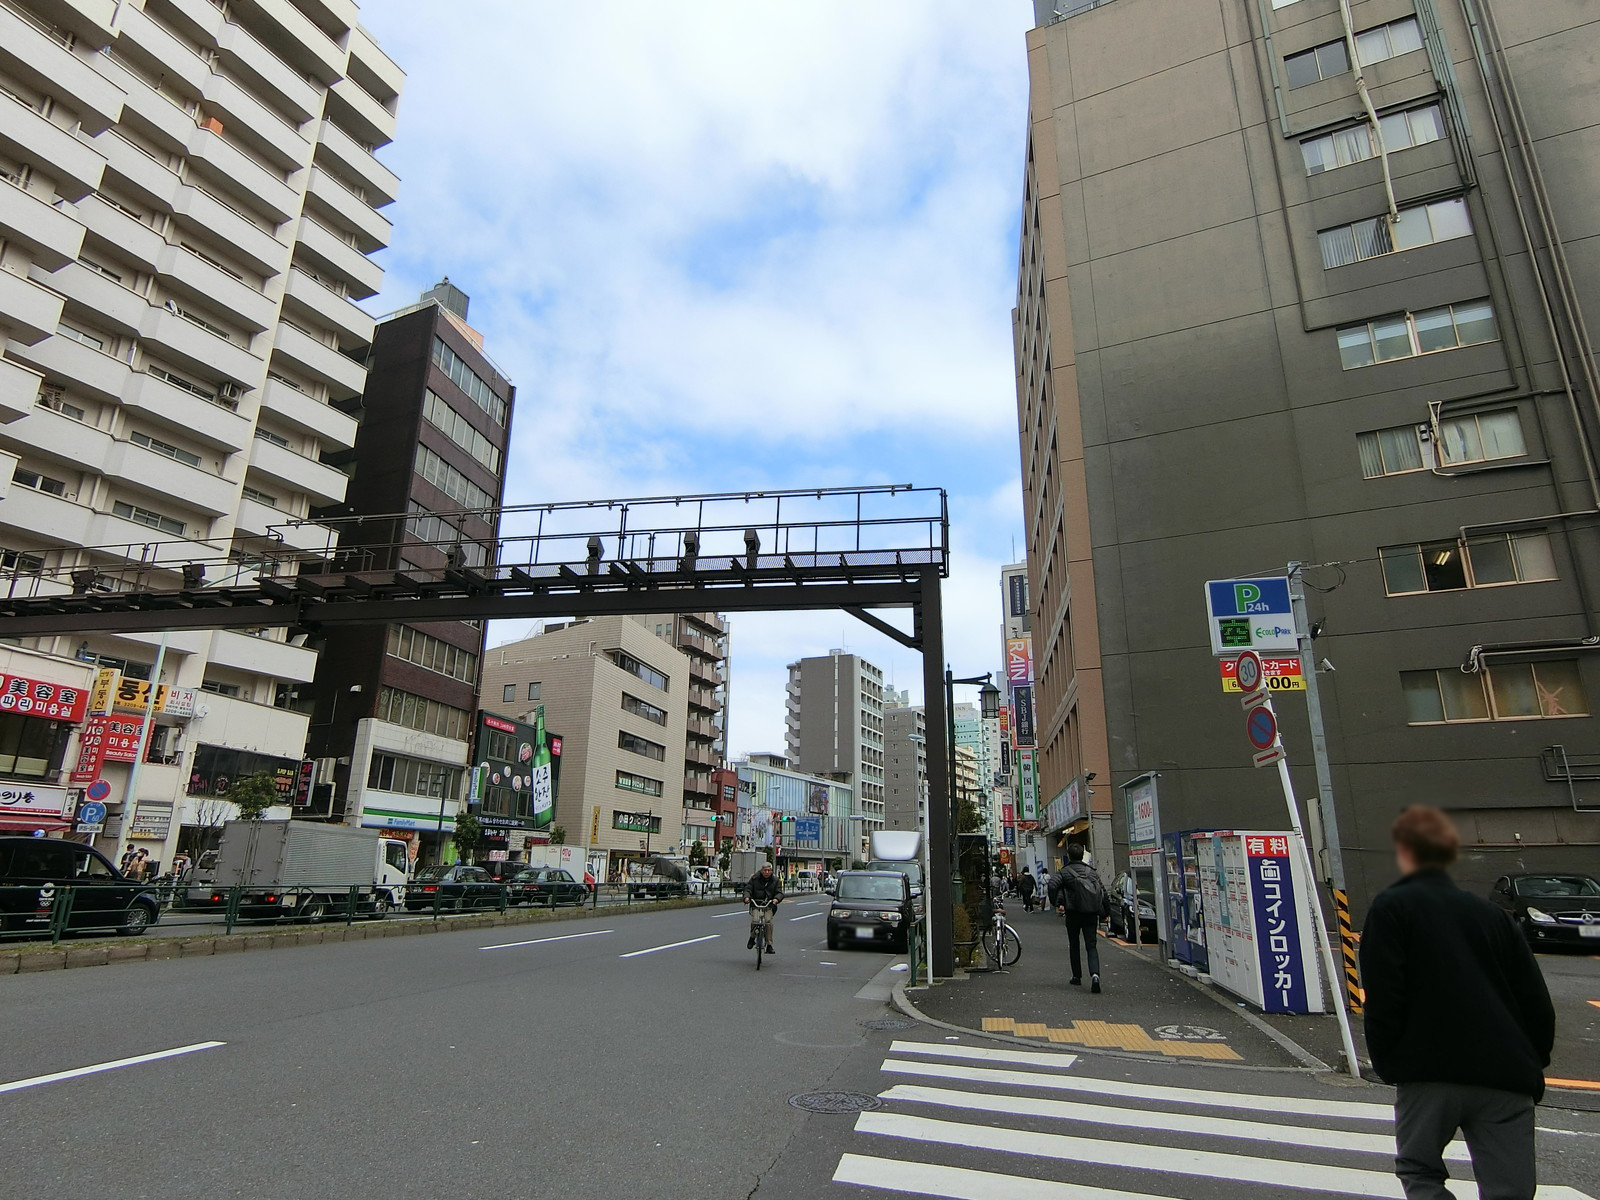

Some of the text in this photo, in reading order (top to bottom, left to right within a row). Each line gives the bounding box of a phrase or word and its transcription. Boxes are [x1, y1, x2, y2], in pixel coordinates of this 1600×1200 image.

[1233, 583, 1269, 613] P 24h
[1009, 641, 1026, 680] RAIN
[1225, 660, 1297, 671] クトカード
[1241, 661, 1256, 682] 30
[8, 678, 78, 705] 美容室
[94, 680, 109, 710] 부동산
[1265, 677, 1299, 689] 00円
[171, 691, 192, 702] 비자
[36, 701, 72, 717] 미용실
[1020, 699, 1029, 735] SBJ銀行
[471, 768, 480, 798] FamilyMart
[1022, 764, 1034, 813] 韓国広場
[86, 808, 96, 821] P
[394, 818, 415, 826] FamilyMart
[1247, 838, 1287, 854] 有料
[1264, 883, 1292, 1008] コインロッカー
